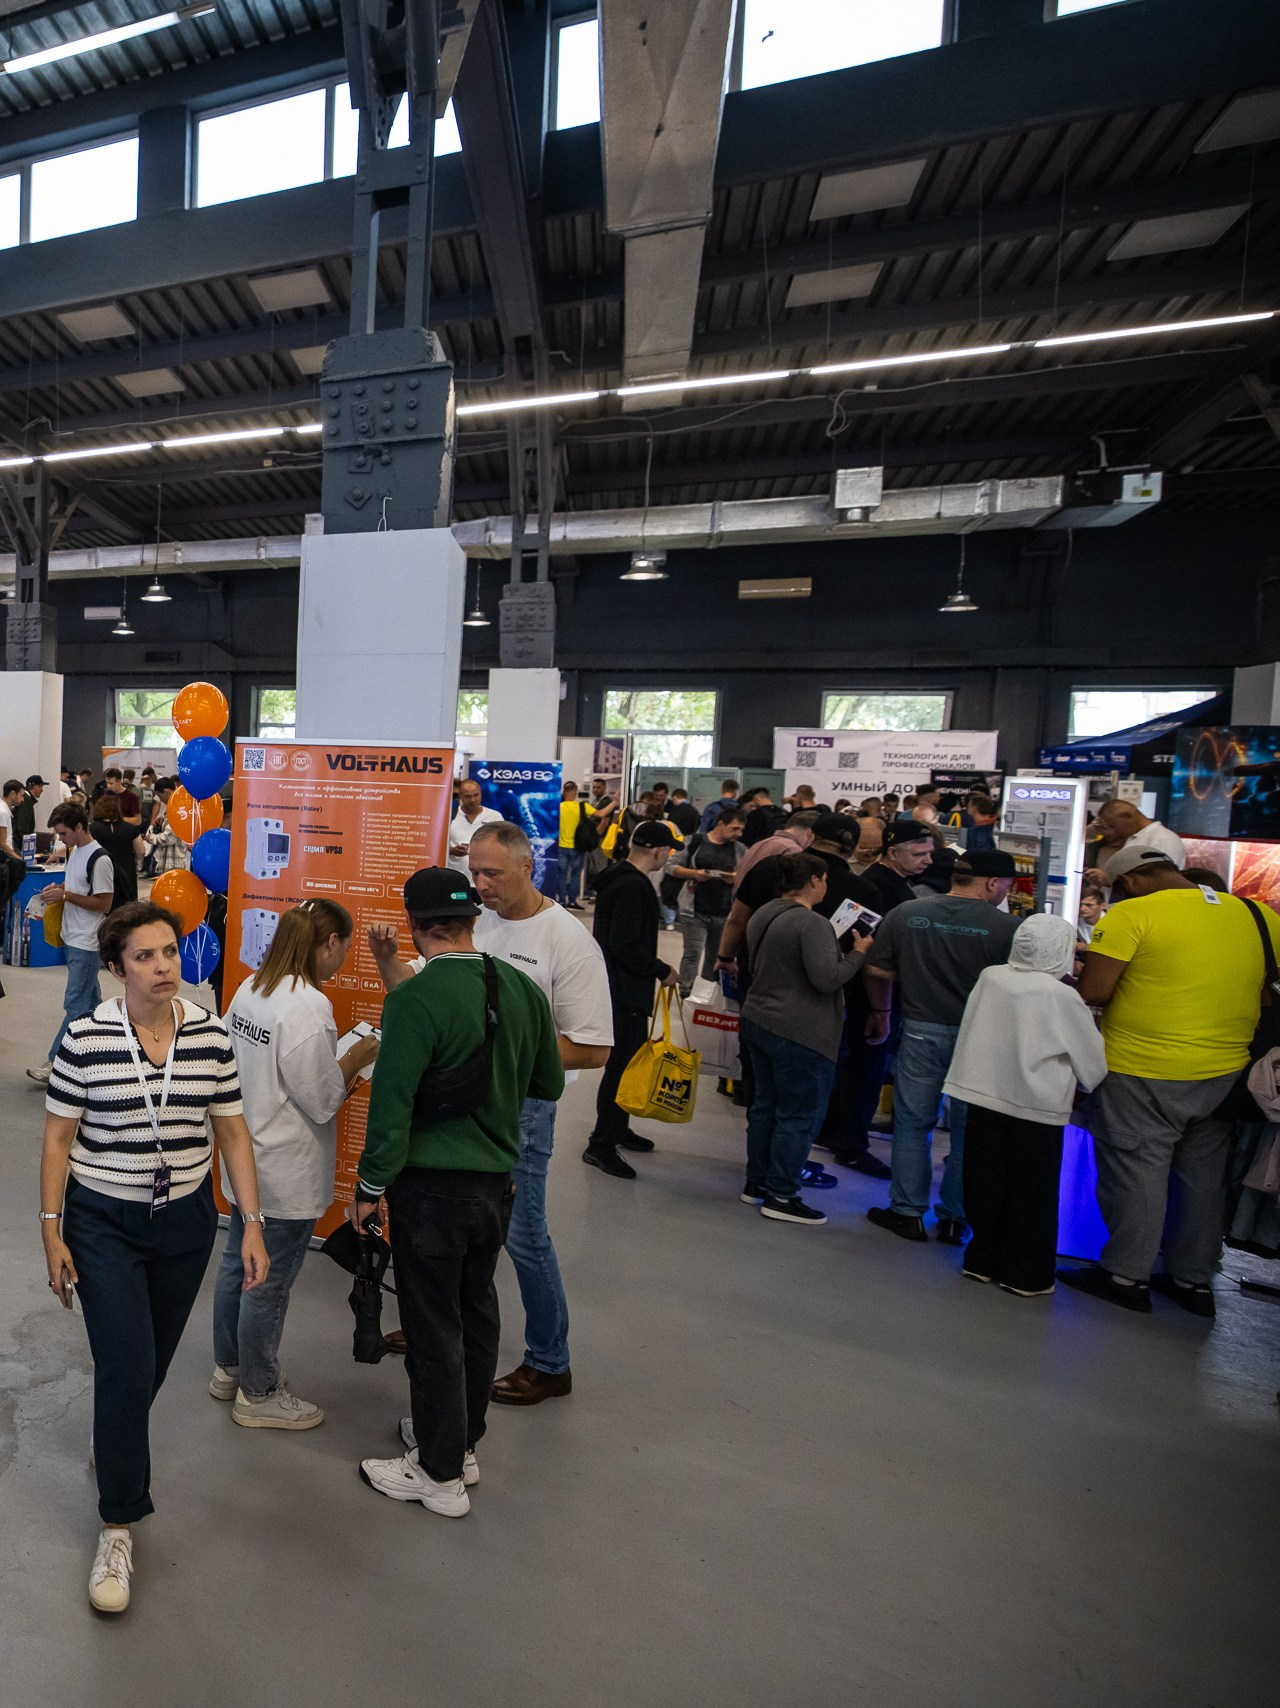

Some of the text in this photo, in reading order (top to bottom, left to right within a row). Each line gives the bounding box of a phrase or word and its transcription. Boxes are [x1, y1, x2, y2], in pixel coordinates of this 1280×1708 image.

[799, 738, 830, 747] HDL
[883, 752, 972, 762] ТЕХНОЛОГИИ ДЛЯ
[326, 754, 443, 774] VOLTHAUS
[881, 761, 976, 770] ПРОФЕССИОНАЛОВ
[493, 769, 532, 780] КЭАЗ
[831, 781, 888, 793] УМНЫЙ
[300, 805, 323, 813] (Relay)
[303, 845, 325, 854] серия
